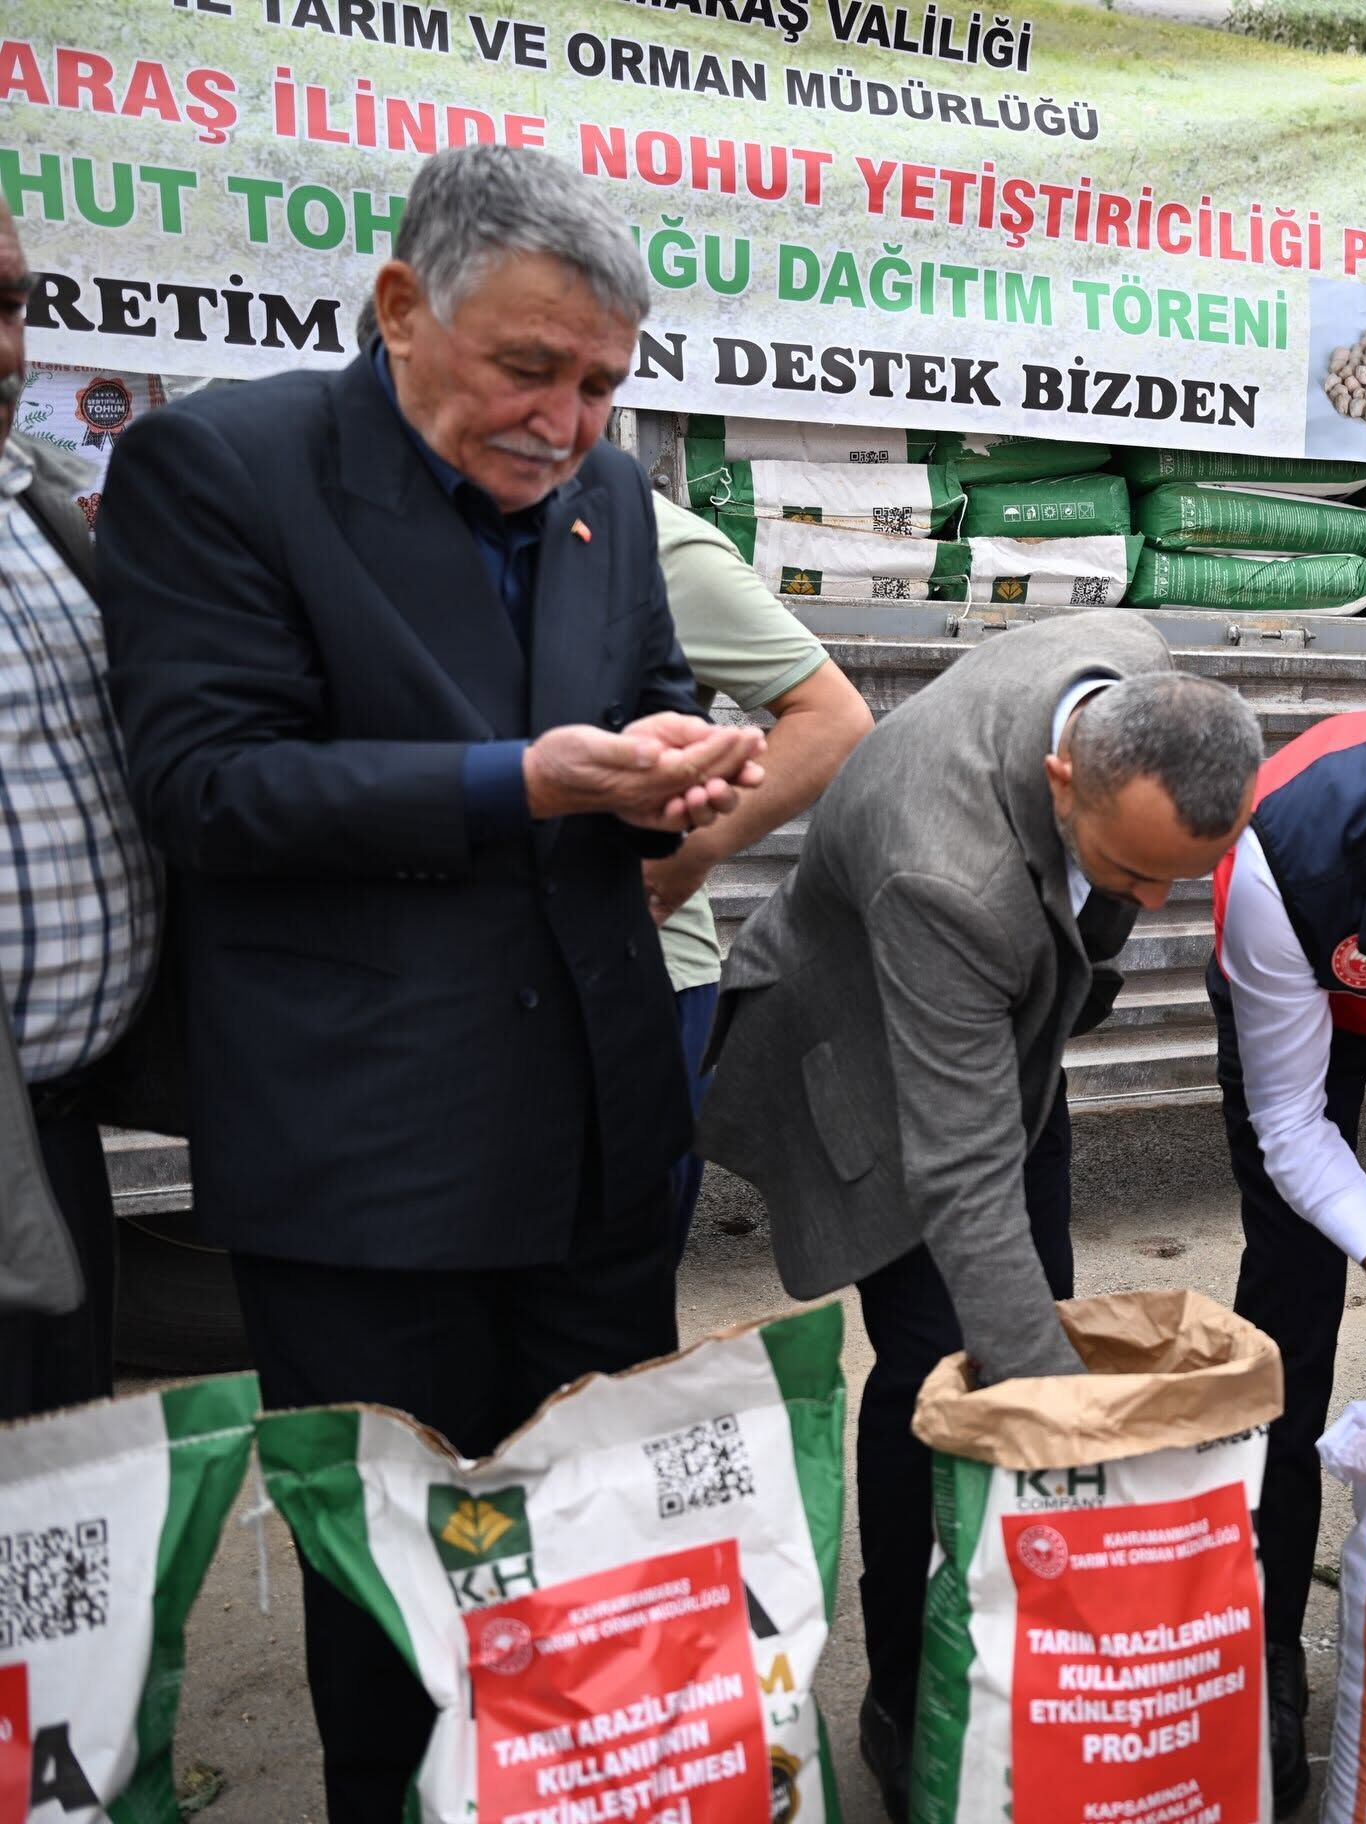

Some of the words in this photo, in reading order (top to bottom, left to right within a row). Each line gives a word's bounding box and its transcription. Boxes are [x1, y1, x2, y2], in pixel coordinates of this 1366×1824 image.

[829, 0, 1032, 72] VALİLİĞİ
[469, 16, 547, 69] VE
[567, 32, 767, 101] ORMAN
[785, 68, 1098, 141] MÜDÜRLÜĞÜ
[0, 40, 237, 144] ARAŞ
[274, 66, 545, 155] İLİNDE
[579, 123, 833, 206] NOHUT
[855, 161, 1321, 271] YETİŞTİRİCİLİĞİ
[778, 243, 1052, 326] DAĞITIM
[1072, 274, 1288, 350] TÖRENİ
[88, 405, 125, 413] TOHUM
[713, 337, 1001, 407] DESTEK
[1021, 355, 1259, 429] BİZDEN
[1027, 1628, 1097, 1655] TARIM
[1099, 1606, 1250, 1658] ARAZİLERİNİN
[1029, 1665, 1246, 1728] ETKİNLEŞTİRİLMESİ
[1058, 1648, 1221, 1691] KULLANIMININ
[1082, 1711, 1200, 1764] PROJESİ
